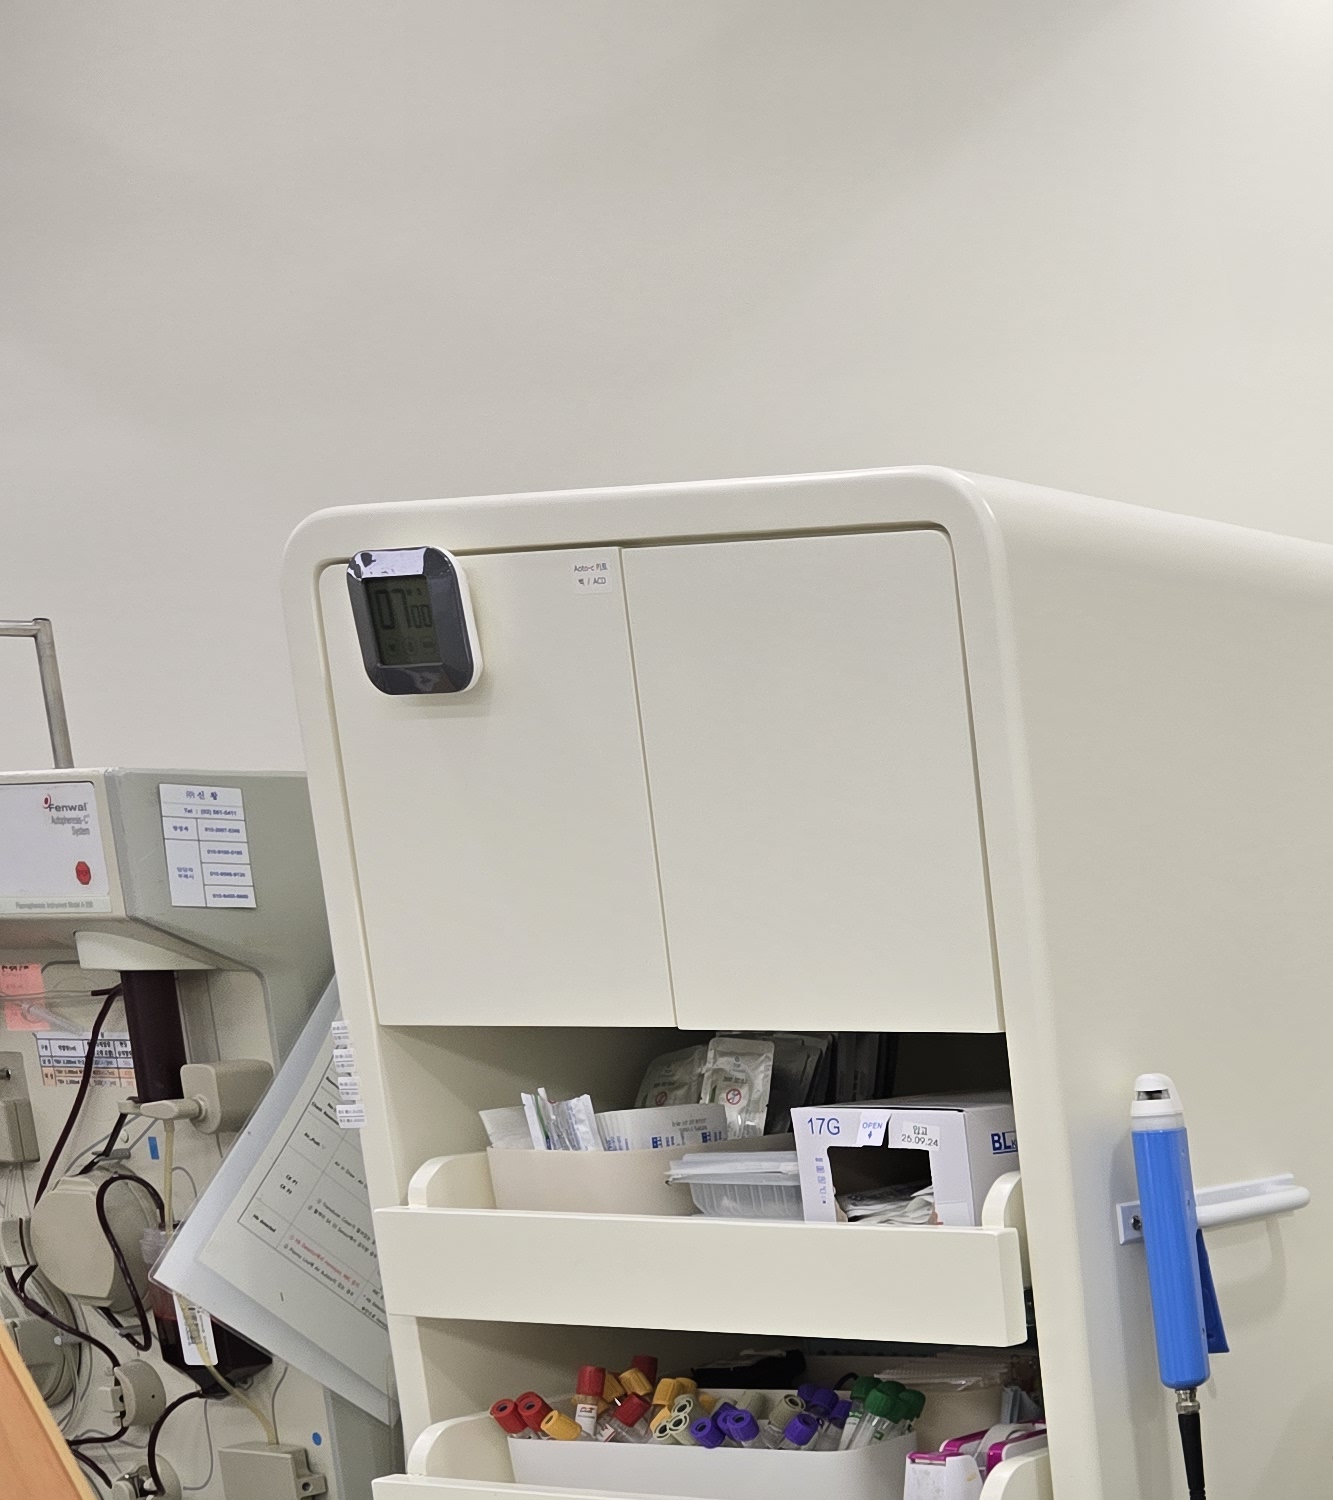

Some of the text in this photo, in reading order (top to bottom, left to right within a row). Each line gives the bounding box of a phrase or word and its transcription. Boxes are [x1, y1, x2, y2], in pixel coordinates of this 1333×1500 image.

[49, 802, 88, 812] Fenwal
[807, 1117, 841, 1136] 17G
[862, 1121, 884, 1131] OPEN
